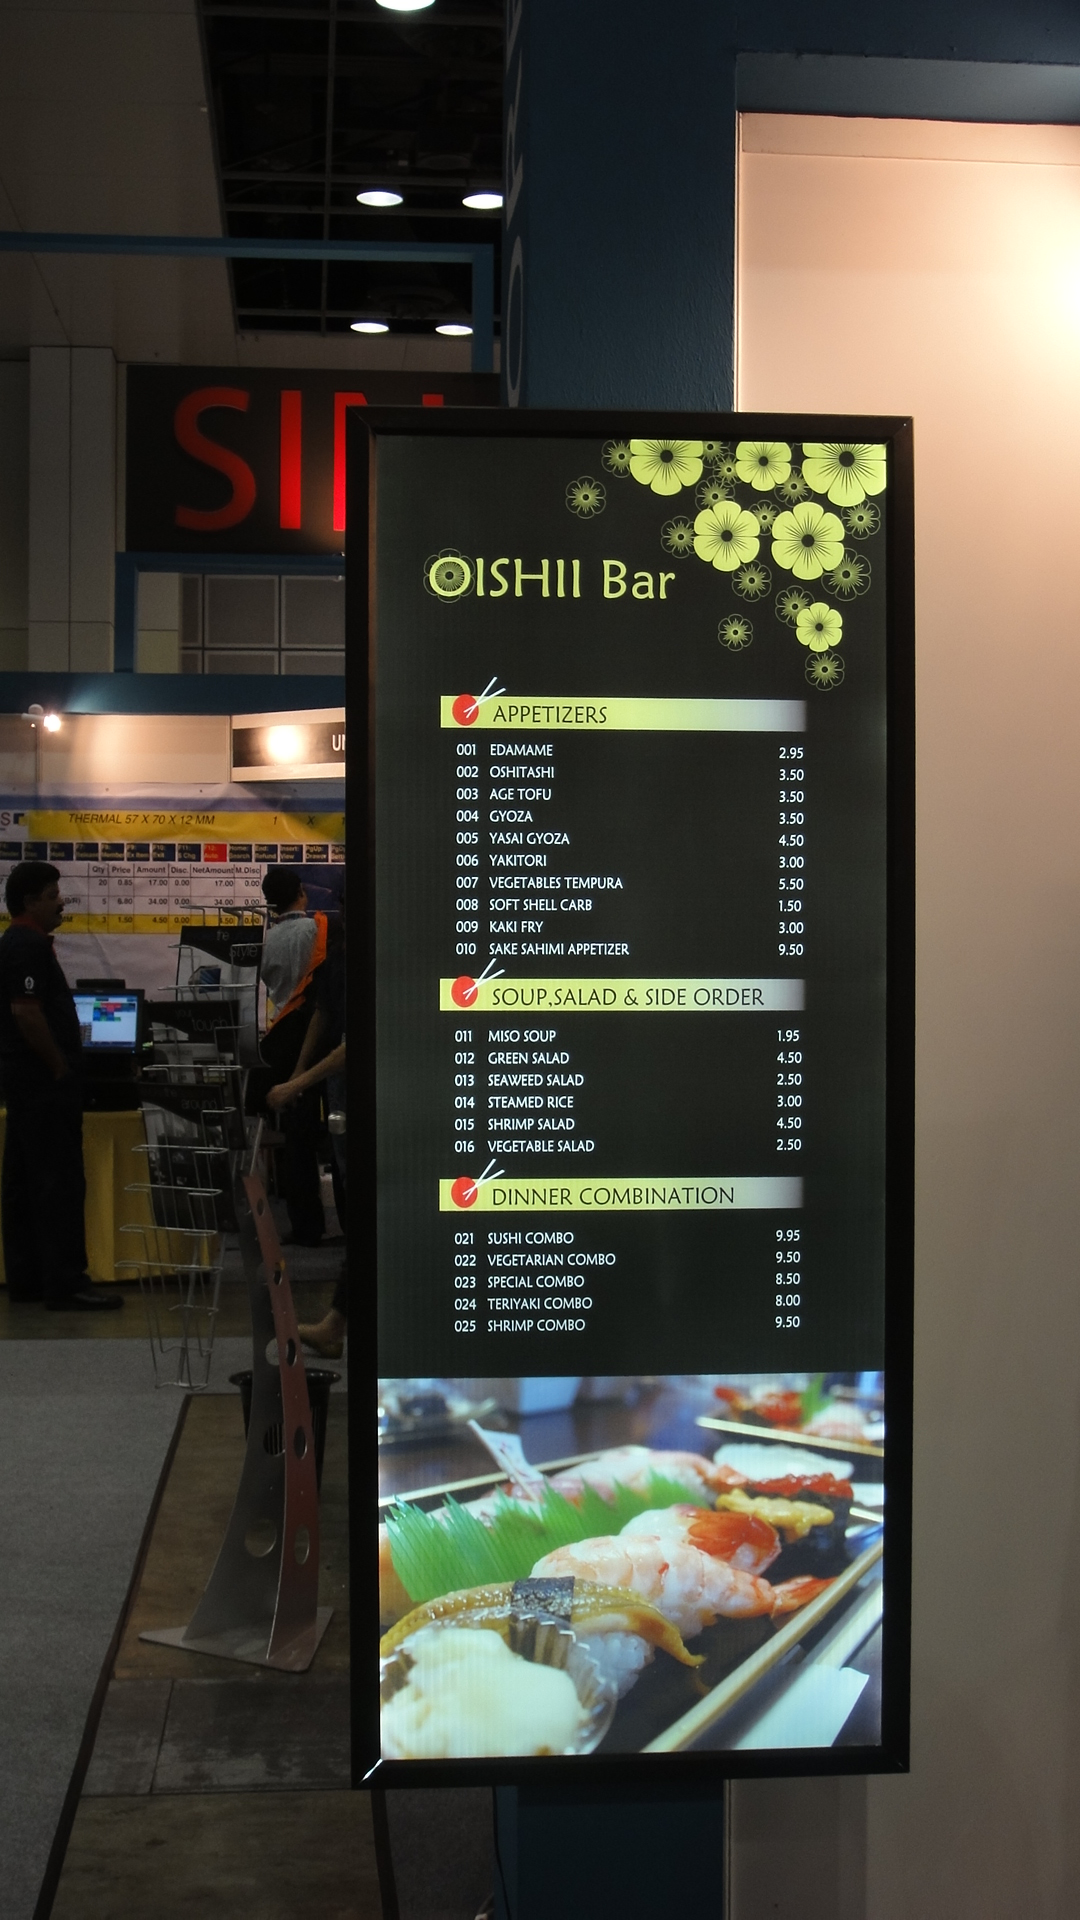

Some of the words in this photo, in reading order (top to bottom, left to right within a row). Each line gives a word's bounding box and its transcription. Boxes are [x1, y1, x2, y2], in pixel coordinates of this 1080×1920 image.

[429, 556, 581, 597] OISHII
[602, 559, 676, 599] Bar
[493, 705, 607, 723] APPETIZERS
[457, 744, 476, 755] 001
[491, 744, 553, 756] EDAMAME
[779, 747, 803, 759] 2.95
[457, 766, 478, 777] 002
[490, 766, 554, 778] OSHITASHI
[780, 769, 804, 781] 3.50
[457, 788, 478, 800] 003
[490, 788, 514, 800] AGE
[517, 788, 551, 800] TOFU
[779, 791, 804, 802] 3.50
[68, 813, 121, 824] THERMAL
[125, 814, 138, 824] 57
[140, 815, 149, 823] X
[153, 815, 165, 824] 70
[168, 815, 177, 824] X
[180, 815, 193, 824] 12
[195, 815, 215, 825] MM
[456, 810, 479, 822] 004
[490, 810, 533, 822] GYOZA
[779, 813, 804, 824] 3.50
[456, 832, 478, 844] 005
[489, 832, 523, 844] YASAI
[527, 832, 570, 844] GYOZA
[779, 835, 804, 846] 4.50
[456, 854, 478, 866] 006
[489, 855, 546, 866] YAKITORI
[779, 856, 804, 868] 3.00
[92, 866, 105, 874] Qty
[112, 866, 131, 874] Price
[137, 866, 166, 874] Amount
[171, 866, 189, 874] Disc.
[193, 866, 234, 875] NetAmount
[456, 877, 478, 888] 007
[489, 877, 561, 888] VEGETABLES
[564, 877, 623, 889] TEMPURA
[779, 878, 804, 890] 5.50
[456, 899, 478, 910] 008
[490, 899, 520, 910] SOFT
[523, 899, 557, 910] SHELL
[560, 899, 592, 911] CARB
[779, 900, 801, 912] 1.50
[456, 921, 478, 932] 009
[490, 921, 517, 932] KAKI
[521, 921, 543, 933] FRY
[779, 922, 804, 934] 3.00
[456, 943, 476, 955] 010
[489, 943, 518, 955] SAKE
[521, 943, 564, 955] SAHIMI
[568, 943, 629, 955] APPETIZER
[779, 944, 803, 955] 9.50
[493, 988, 616, 1007] SOUP,SALAD
[624, 989, 638, 1005] &
[646, 989, 686, 1005] SIDE
[694, 988, 764, 1005] ORDER
[455, 1030, 472, 1042] 011
[488, 1030, 520, 1042] MISO
[524, 1030, 556, 1042] SOUP
[778, 1030, 799, 1042] 1.95
[455, 1052, 474, 1064] 012
[488, 1052, 528, 1064] GREEN
[532, 1052, 569, 1064] SALAD
[777, 1052, 802, 1063] 4.50
[455, 1074, 474, 1086] 013
[488, 1074, 543, 1086] SEAWEED
[547, 1074, 584, 1086] SALAD
[777, 1074, 802, 1085] 2.50
[455, 1097, 475, 1108] 014
[488, 1096, 543, 1108] STEAMED
[547, 1096, 573, 1108] RICE
[777, 1095, 802, 1107] 3.00
[455, 1119, 474, 1130] 015
[488, 1118, 534, 1130] SHRIMP
[538, 1118, 575, 1130] SALAD
[777, 1117, 801, 1129] 4.50
[455, 1141, 474, 1152] 016
[488, 1140, 554, 1152] VEGETABLE
[558, 1140, 594, 1152] SALAD
[777, 1139, 801, 1150] 2.50
[493, 1188, 572, 1205] DINNER
[580, 1187, 733, 1205] COMBINATION
[455, 1233, 473, 1244] 021
[488, 1232, 521, 1244] SUSHI
[525, 1232, 574, 1244] COMBO
[776, 1230, 800, 1241] 9.95
[455, 1255, 476, 1266] 022
[487, 1254, 563, 1266] VEGETARIAN
[567, 1253, 615, 1265] COMBO
[776, 1251, 800, 1263] 9.50
[455, 1276, 476, 1288] 023
[488, 1276, 533, 1288] SPECIAL
[536, 1275, 584, 1287] COMBO
[776, 1273, 800, 1284] 8.50
[455, 1298, 476, 1310] 024
[487, 1298, 540, 1310] TERIYAKI
[544, 1297, 592, 1309] COMBO
[776, 1294, 800, 1306] 8.00
[455, 1320, 476, 1332] 025
[488, 1320, 533, 1332] SHRIMP
[537, 1319, 585, 1331] COMBO
[775, 1316, 800, 1328] 9.50
